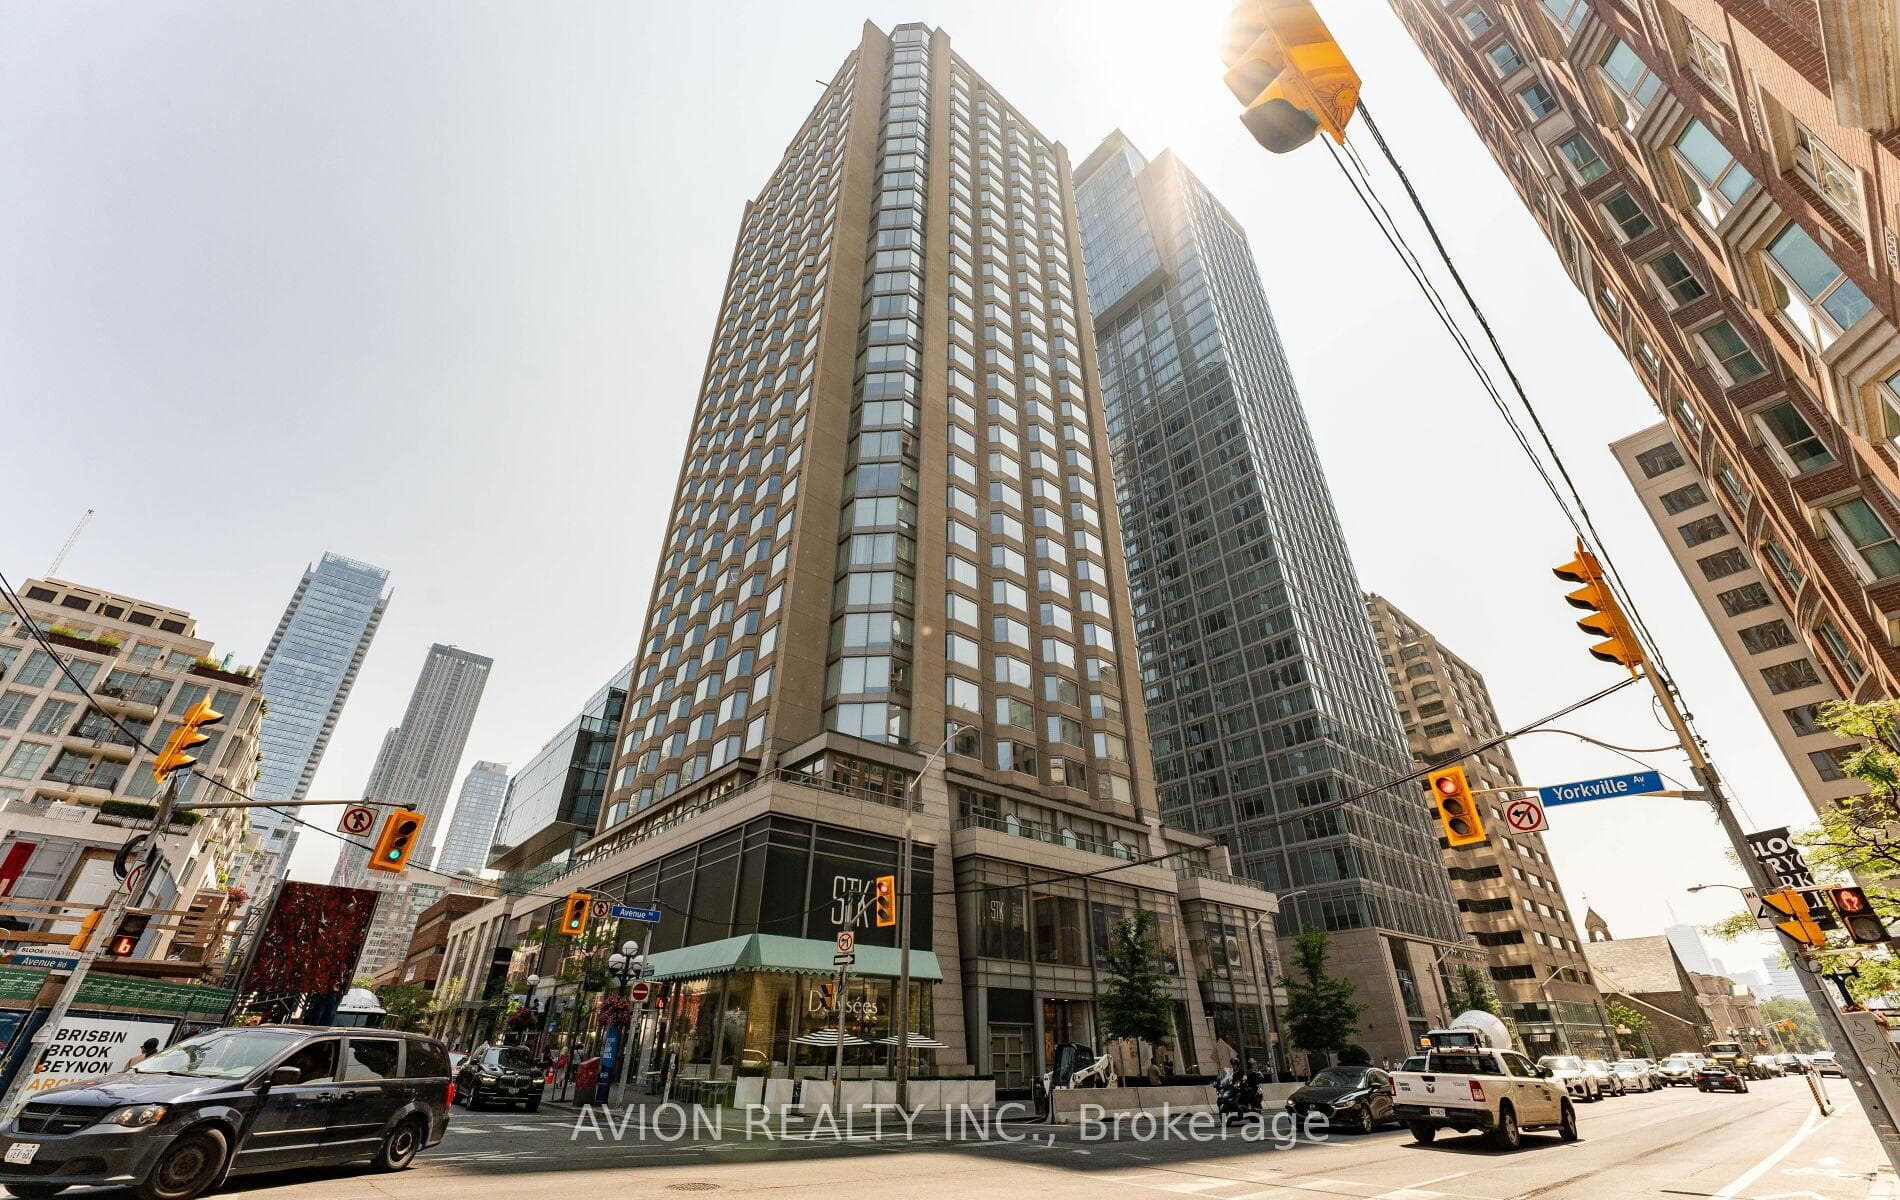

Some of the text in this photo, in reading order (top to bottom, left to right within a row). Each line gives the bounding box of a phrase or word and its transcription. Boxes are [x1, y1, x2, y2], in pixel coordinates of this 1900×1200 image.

[1552, 775, 1645, 801] Yorkville Av
[831, 875, 870, 928] STK
[619, 908, 646, 919] Avenue
[990, 900, 1004, 921] STK
[21, 957, 56, 968] Avenue
[54, 1028, 128, 1044] BRISBIN
[48, 1045, 113, 1058] BROOK
[40, 1061, 114, 1075] BEYNON
